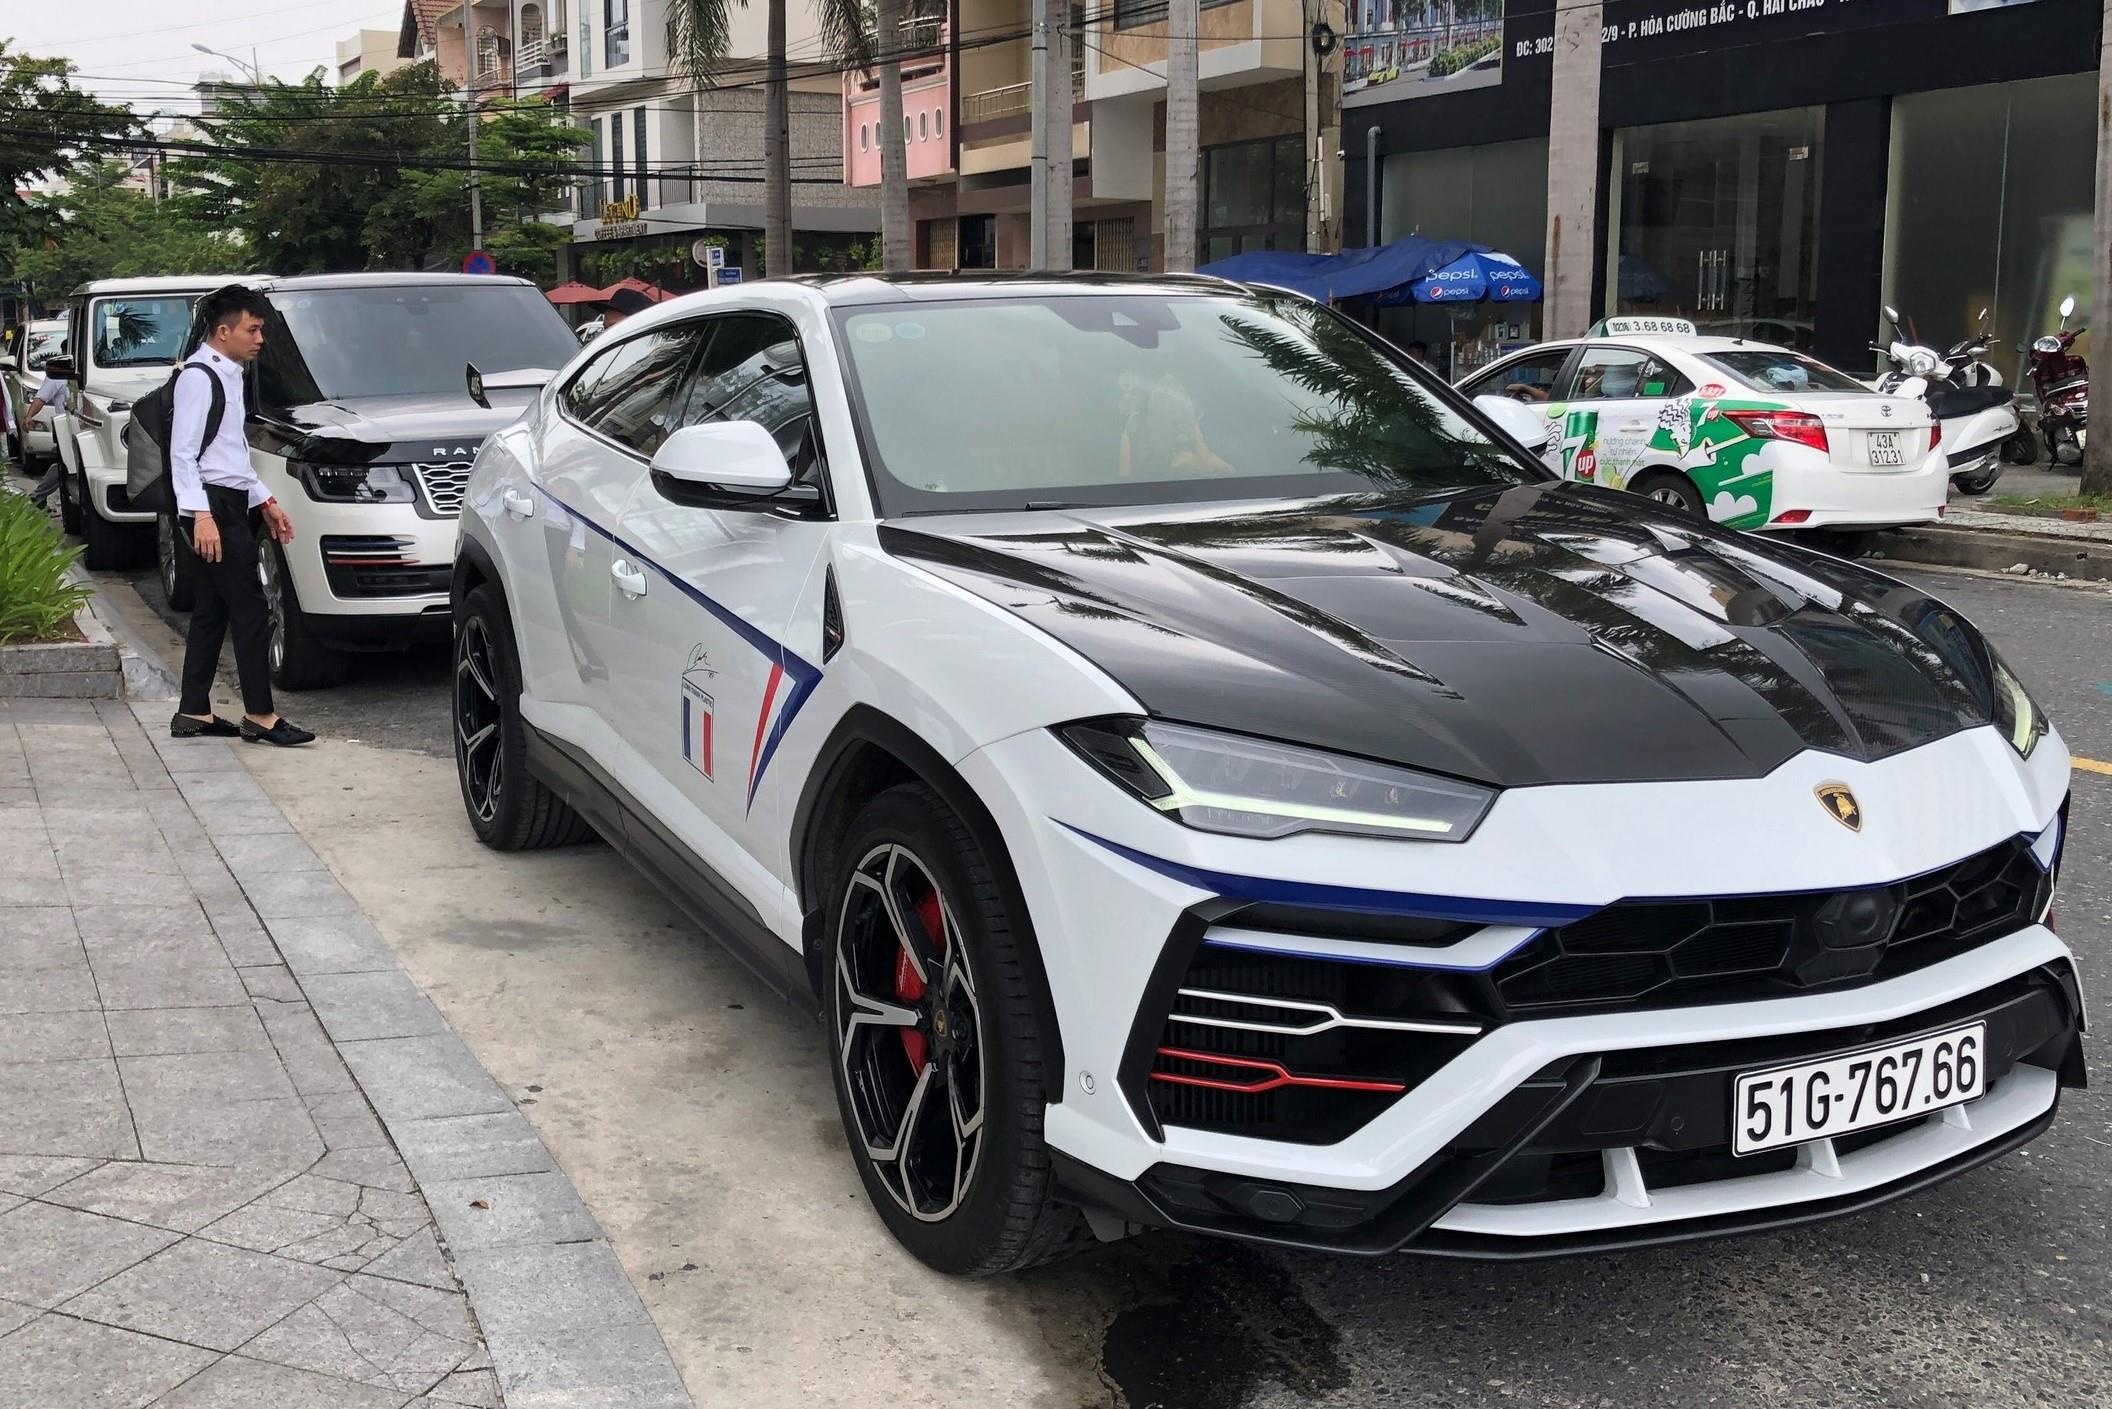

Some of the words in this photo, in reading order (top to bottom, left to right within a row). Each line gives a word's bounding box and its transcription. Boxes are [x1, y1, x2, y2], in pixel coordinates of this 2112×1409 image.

[1516, 40, 1533, 57] ĐC:
[1535, 37, 1554, 54] 302
[1628, 22, 1638, 39] P.
[1641, 14, 1663, 36] HÒA
[1666, 6, 1707, 33] CƯỜNG
[1747, 1, 1759, 20] Q.
[1425, 268, 1476, 282] pepsi
[1489, 269, 1526, 282] pepsi
[1443, 287, 1469, 296] pepsi
[1510, 287, 1529, 295] pepsi
[1661, 321, 1674, 333] 68
[1676, 322, 1690, 334] 68
[1876, 434, 1894, 449] 43A
[1747, 1036, 1977, 1142] 51G-767.66
